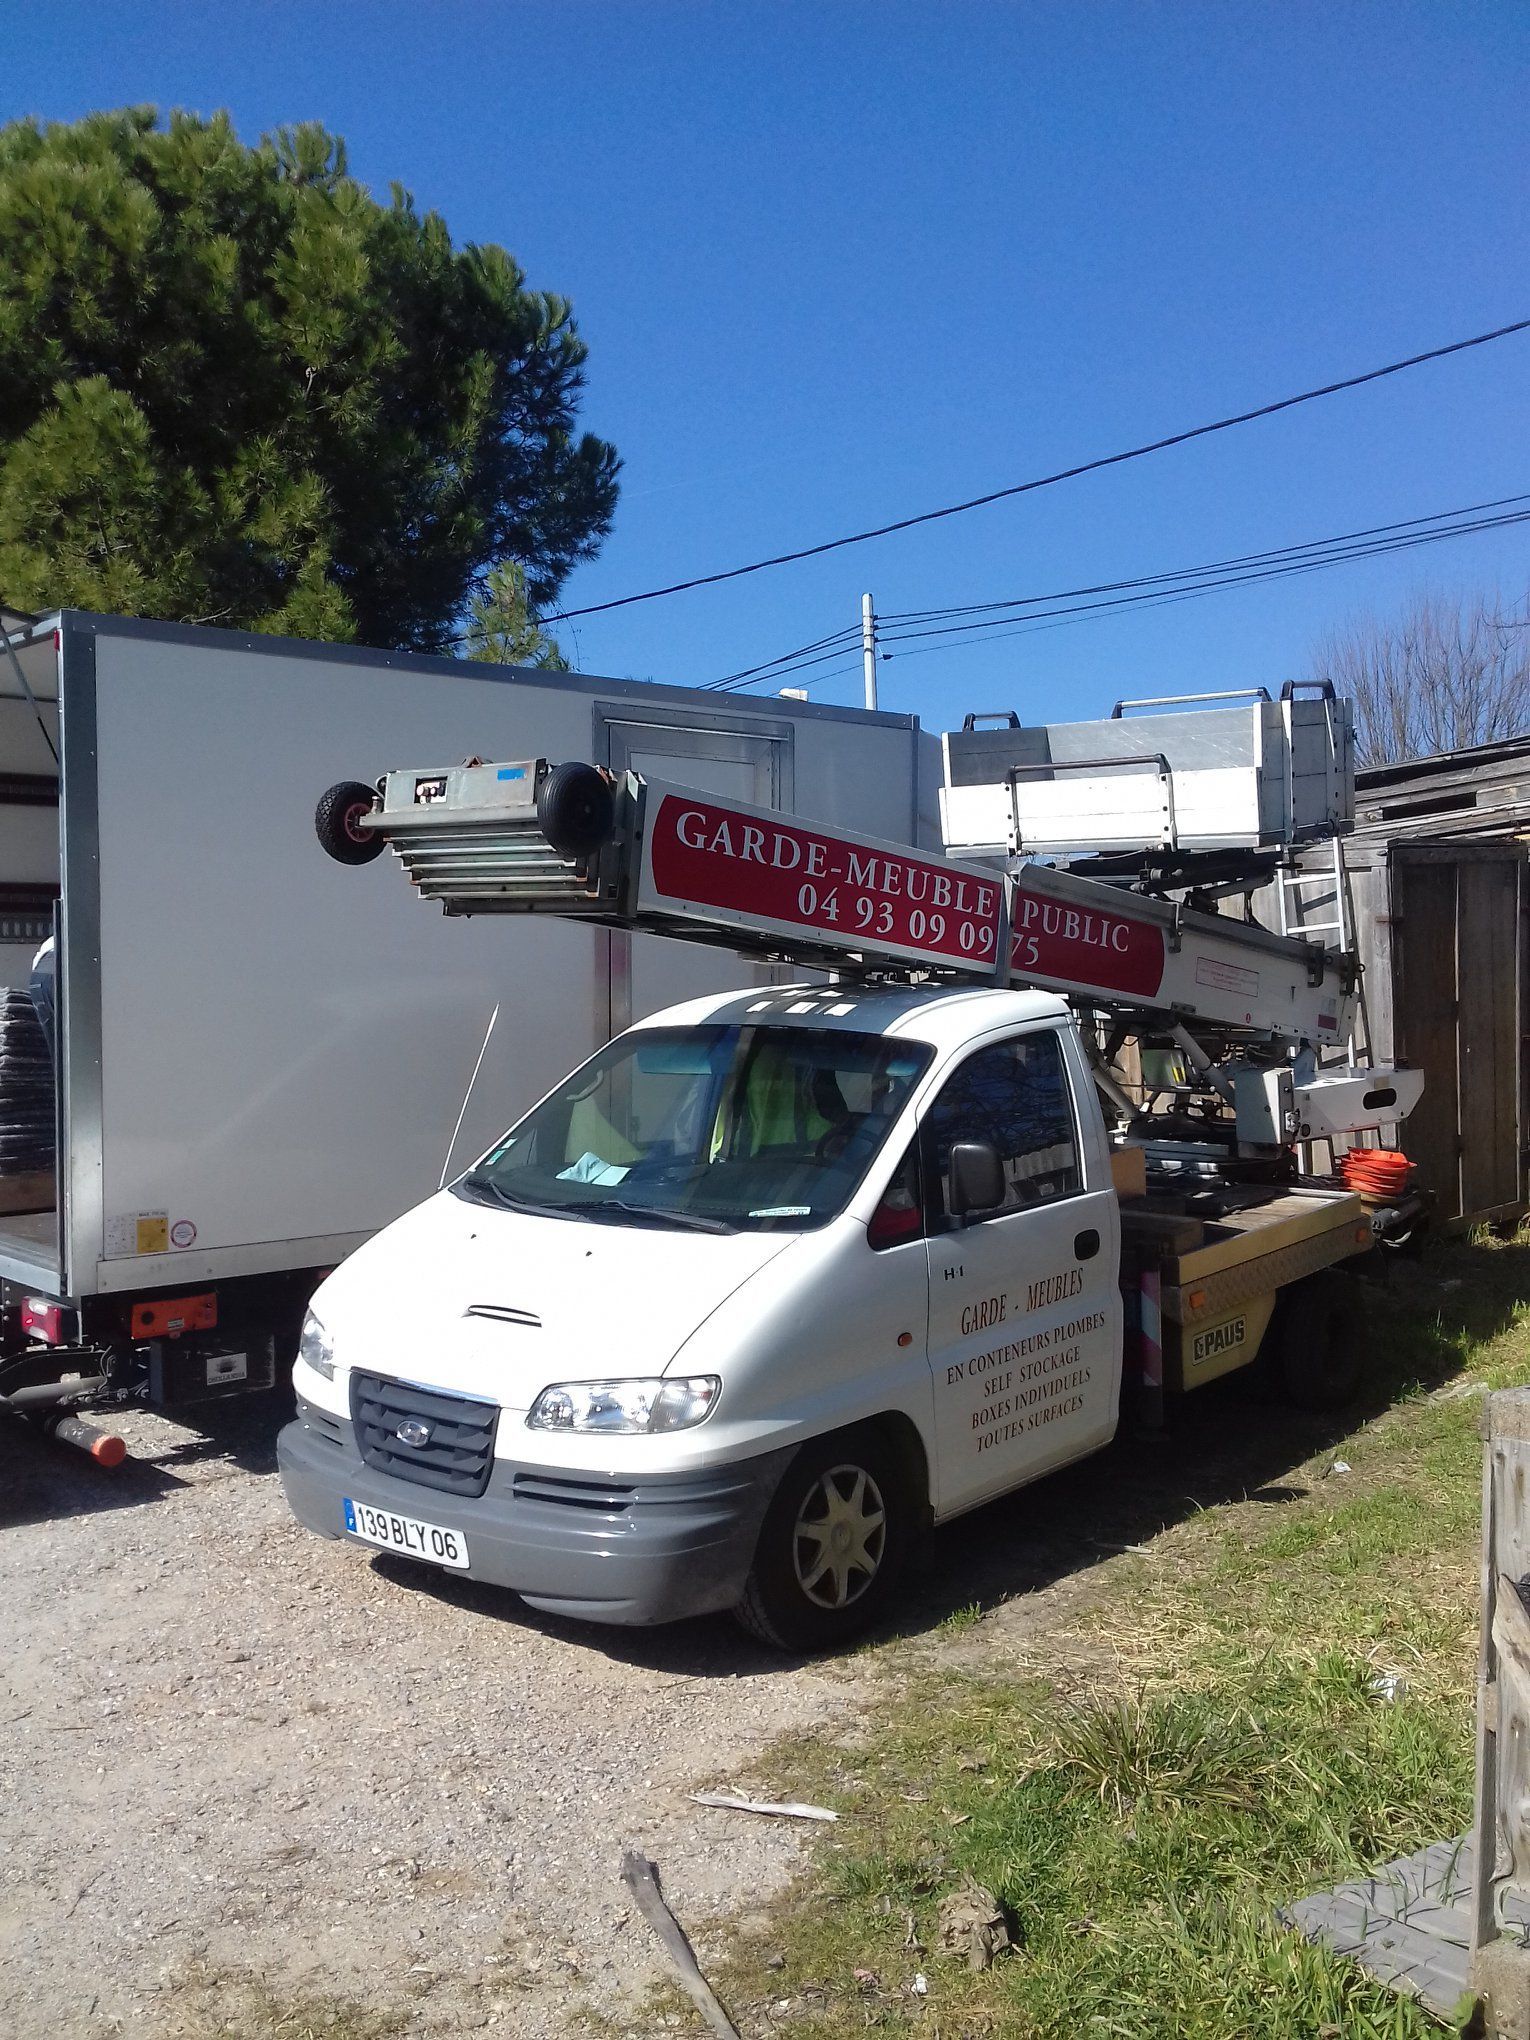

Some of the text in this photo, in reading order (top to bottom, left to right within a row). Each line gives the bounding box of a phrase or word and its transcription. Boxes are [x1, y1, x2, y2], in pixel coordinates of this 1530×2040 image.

[676, 811, 1130, 952] GARDE-MEUBLE PUBLIC
[798, 883, 1040, 966] 04 93 09 09 75
[961, 1293, 1007, 1336] GARDE
[1026, 1267, 1084, 1313] MEUBLES
[946, 1363, 964, 1386] EN
[968, 1330, 1050, 1377] CONTENEURS
[984, 1345, 1081, 1398] SELF STOCKAGE
[971, 1366, 1092, 1430] BOXES INDIVIDUELS
[977, 1393, 1085, 1453] TOUTES SURFACES
